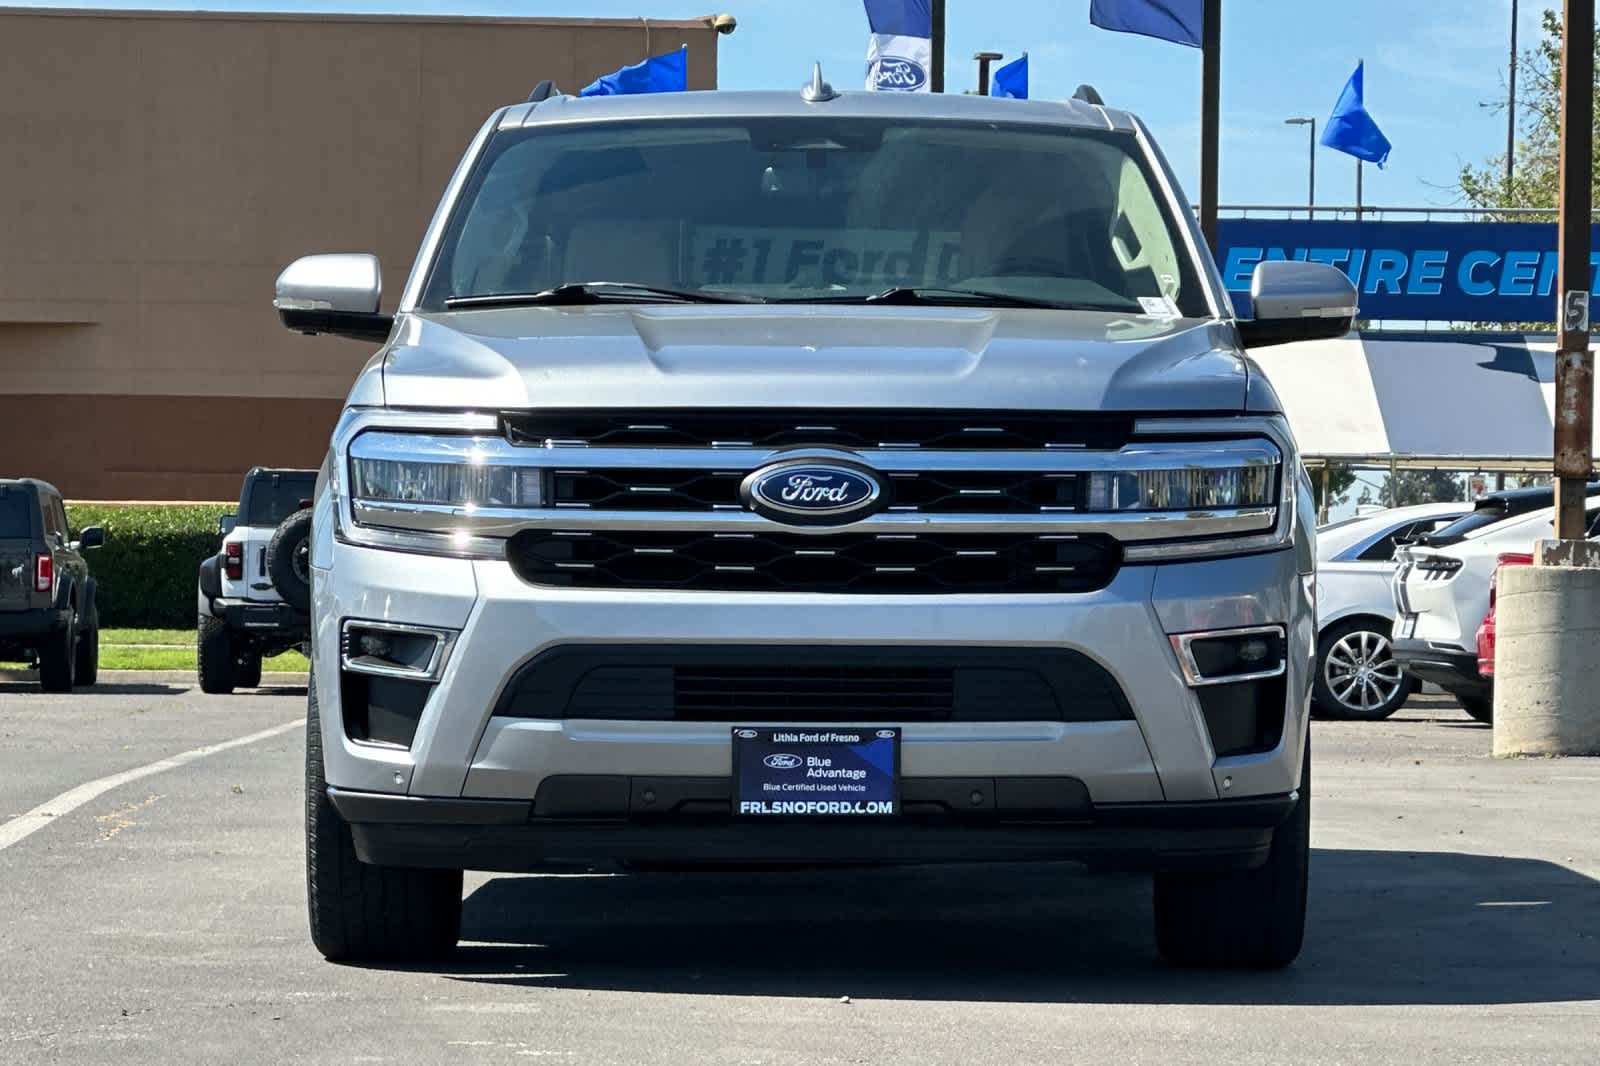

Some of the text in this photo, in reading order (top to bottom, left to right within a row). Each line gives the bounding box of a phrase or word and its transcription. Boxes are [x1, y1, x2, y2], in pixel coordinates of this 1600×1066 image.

[703, 238, 771, 285] #1
[784, 230, 931, 289] Ford
[782, 474, 849, 501] Ford
[773, 733, 860, 743] Lithia Ford of Fresno
[806, 756, 831, 767] Blue
[806, 768, 867, 780] Advantage
[763, 783, 866, 792] Blue Certified Used Vehicle
